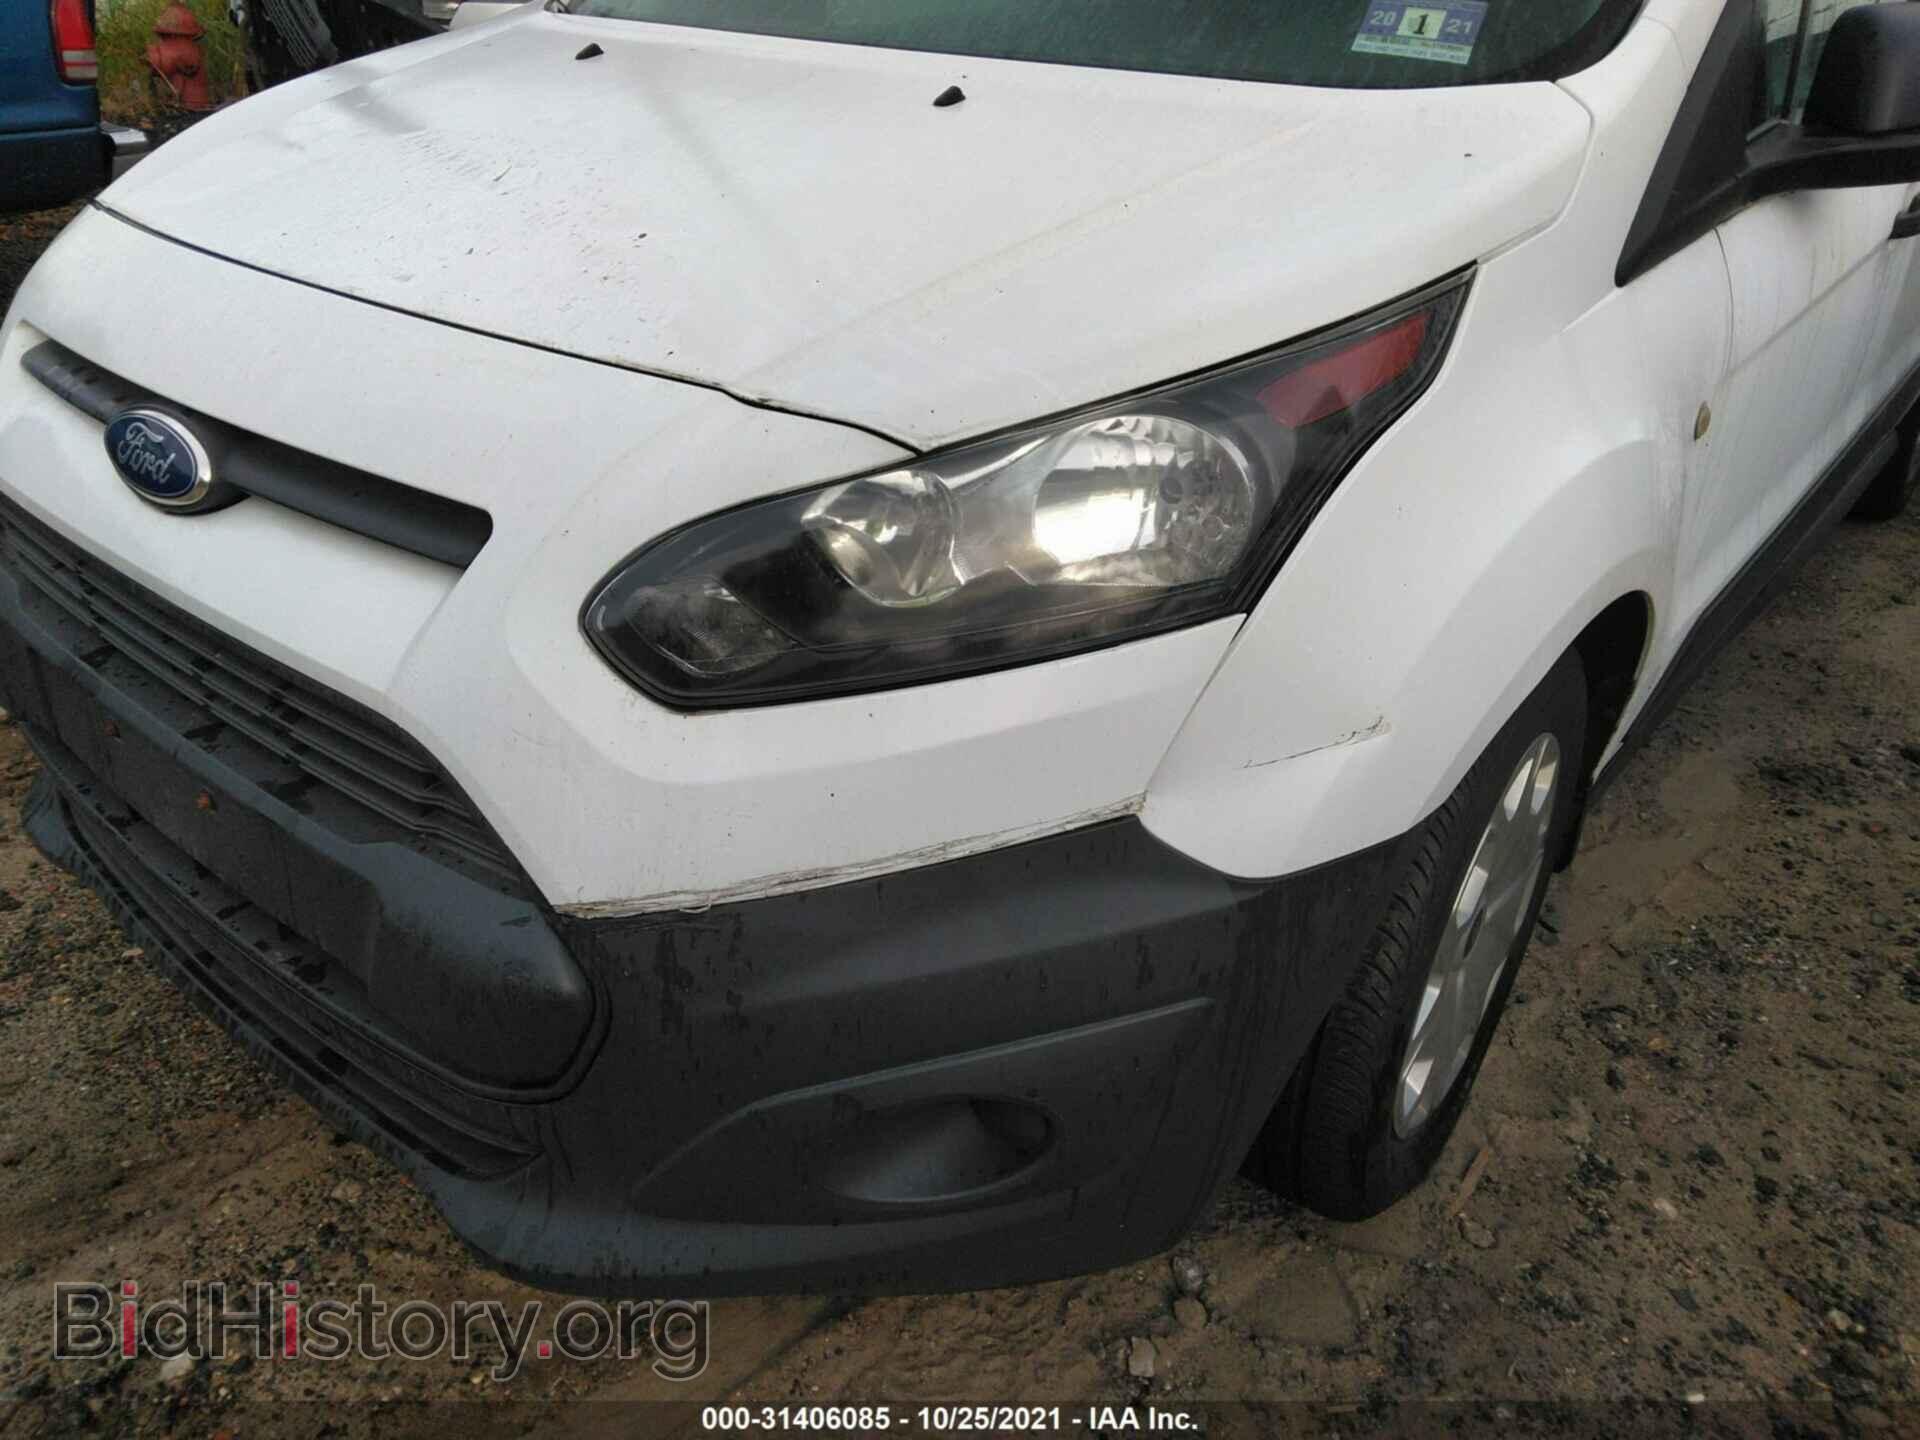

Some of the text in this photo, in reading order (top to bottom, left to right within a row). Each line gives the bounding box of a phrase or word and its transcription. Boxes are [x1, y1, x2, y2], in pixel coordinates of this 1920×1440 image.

[1370, 10, 1473, 35] 20 1 21
[118, 421, 177, 483] Ford
